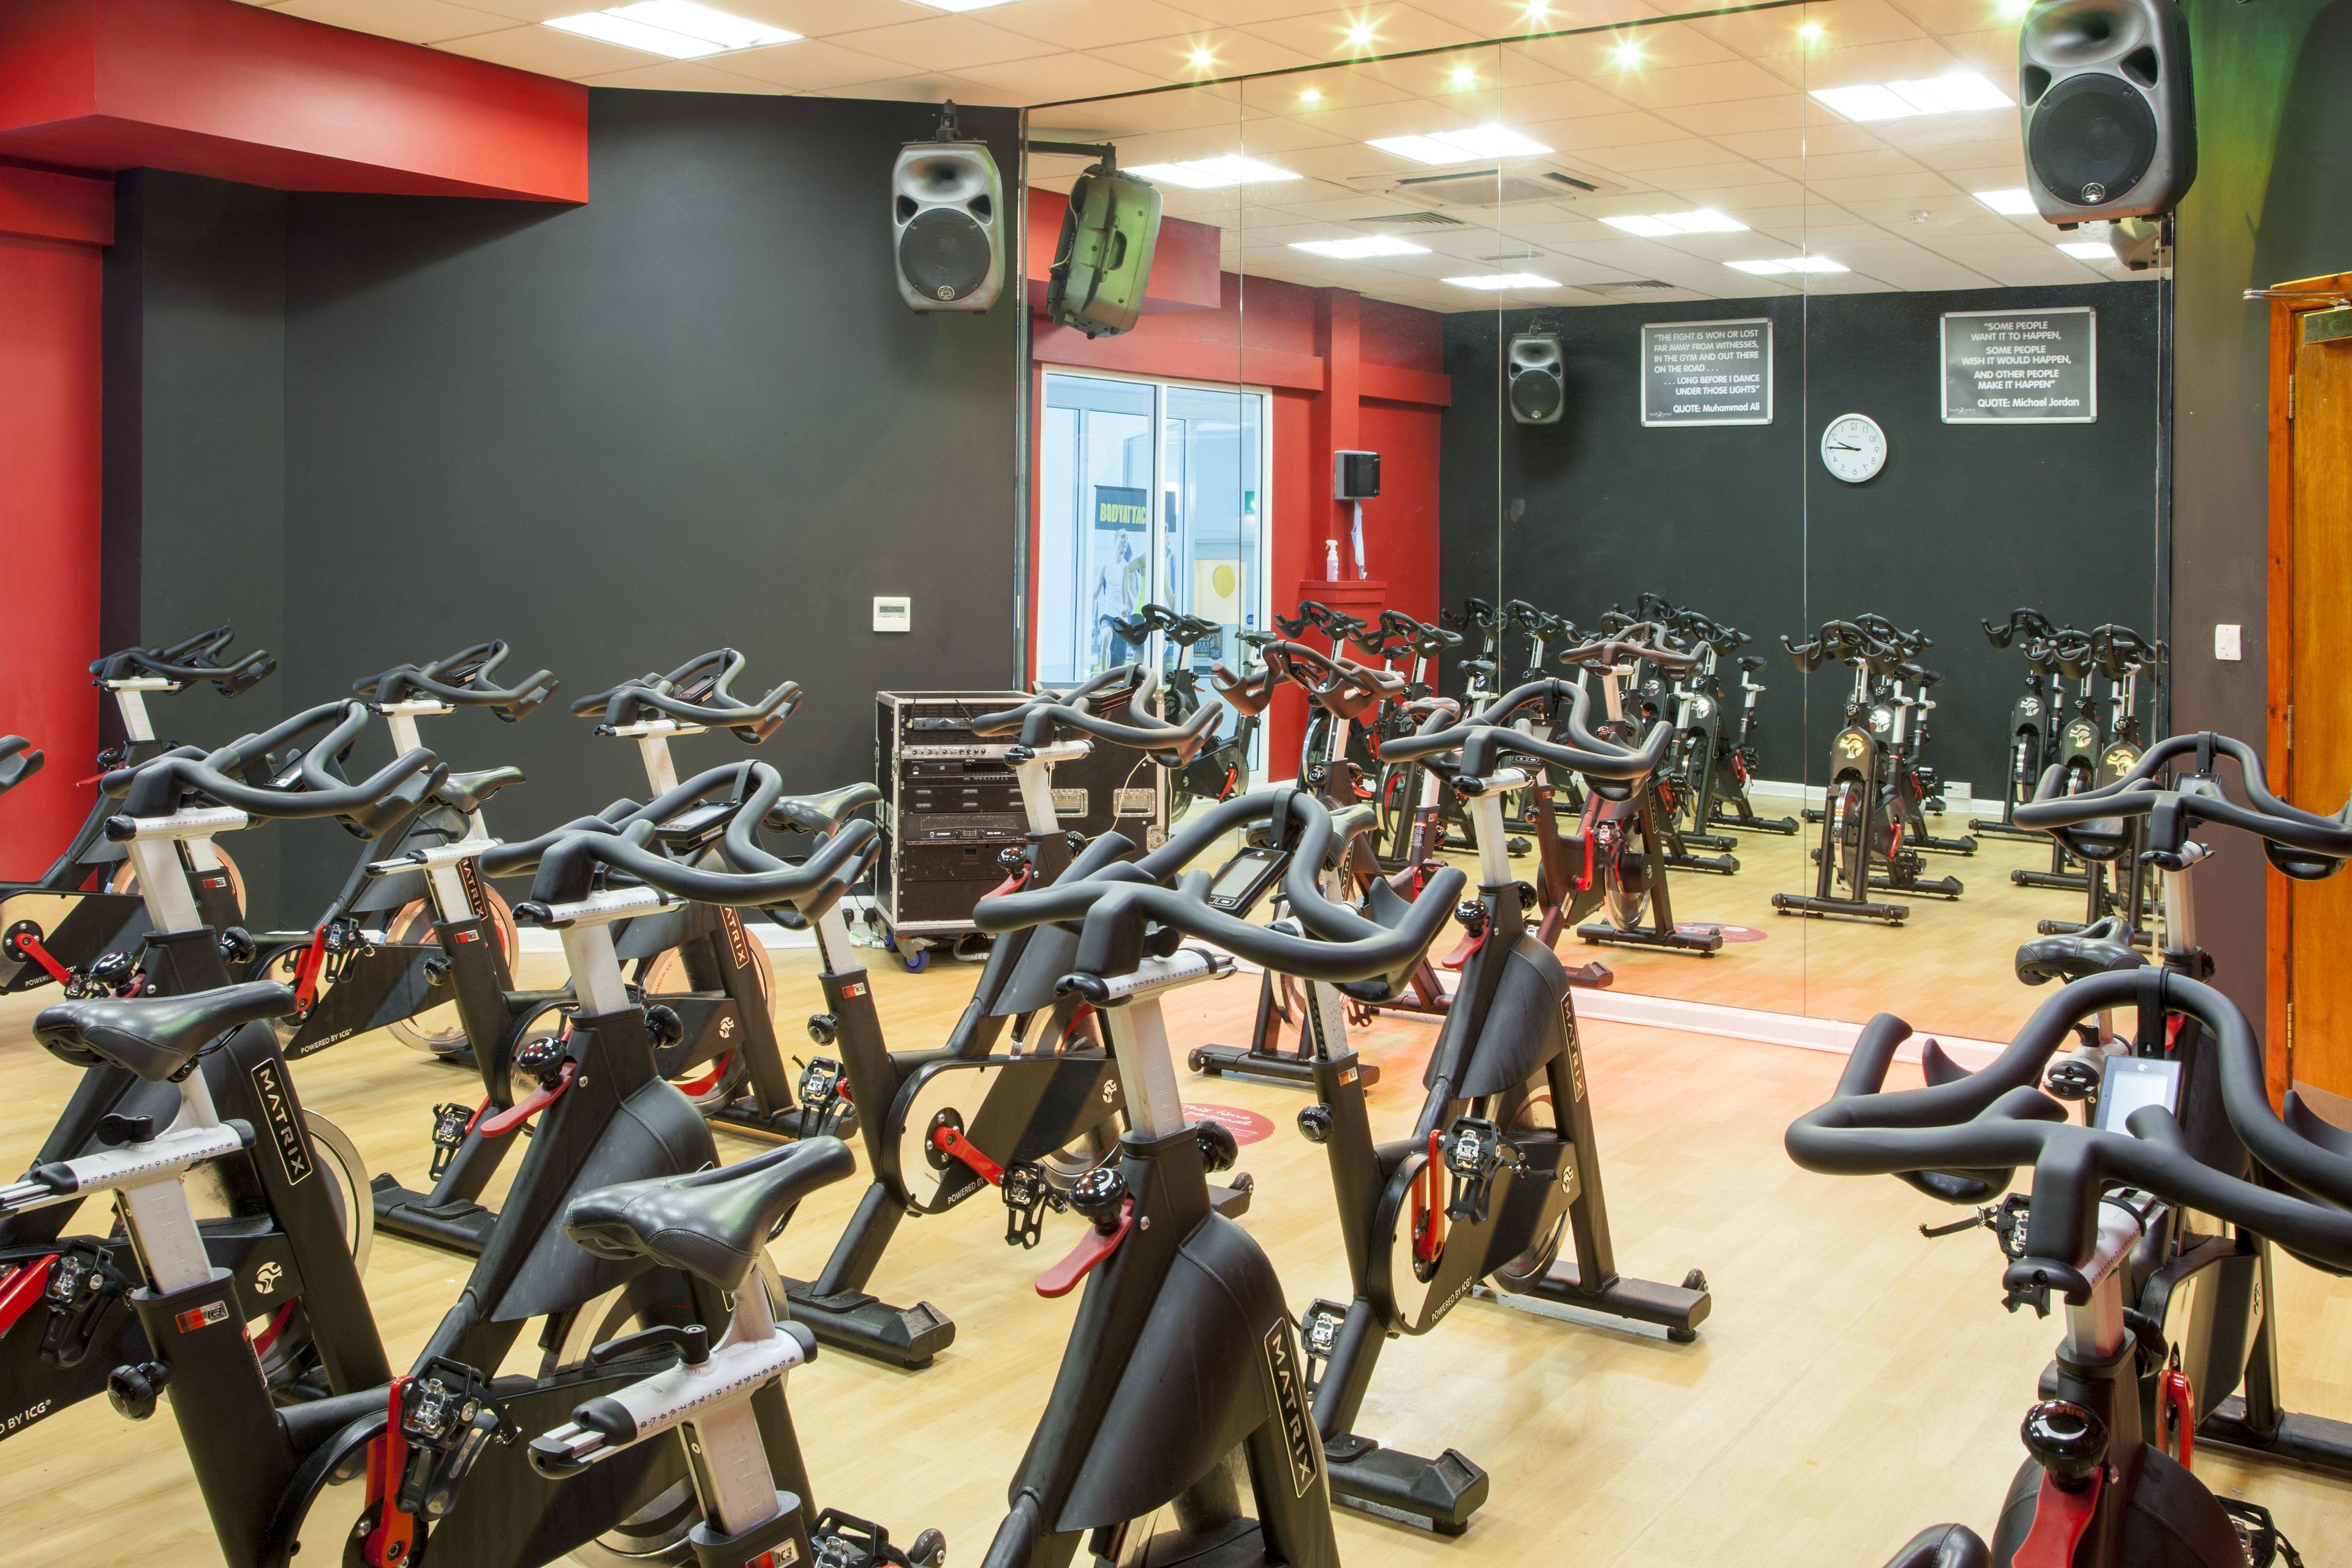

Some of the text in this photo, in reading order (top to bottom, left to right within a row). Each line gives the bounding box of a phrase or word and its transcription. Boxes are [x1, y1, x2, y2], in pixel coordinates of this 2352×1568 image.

[1716, 341, 1758, 349] WITNESSES,
[2023, 332, 2061, 341] HAPPEN,
[2033, 355, 2071, 364] HAPPEN,
[1703, 403, 1748, 412] Muhammad
[1978, 398, 2079, 408] QUOTE: Michael Jordan
[1100, 503, 1146, 524] BODYATTAC
[725, 907, 745, 962] ATRIX
[301, 1038, 330, 1054] POWERED
[331, 1033, 338, 1042] BY
[1565, 1000, 1582, 1093] MATRIX
[260, 1068, 305, 1175] MATRIX
[948, 1182, 976, 1205] POWERED
[208, 1305, 222, 1319] IC3
[1431, 1294, 1454, 1322] POWERED
[1455, 1286, 1461, 1298] BY
[1272, 1333, 1311, 1482] MATRIX
[7, 1414, 22, 1430] BY
[778, 1547, 792, 1563] IC3
